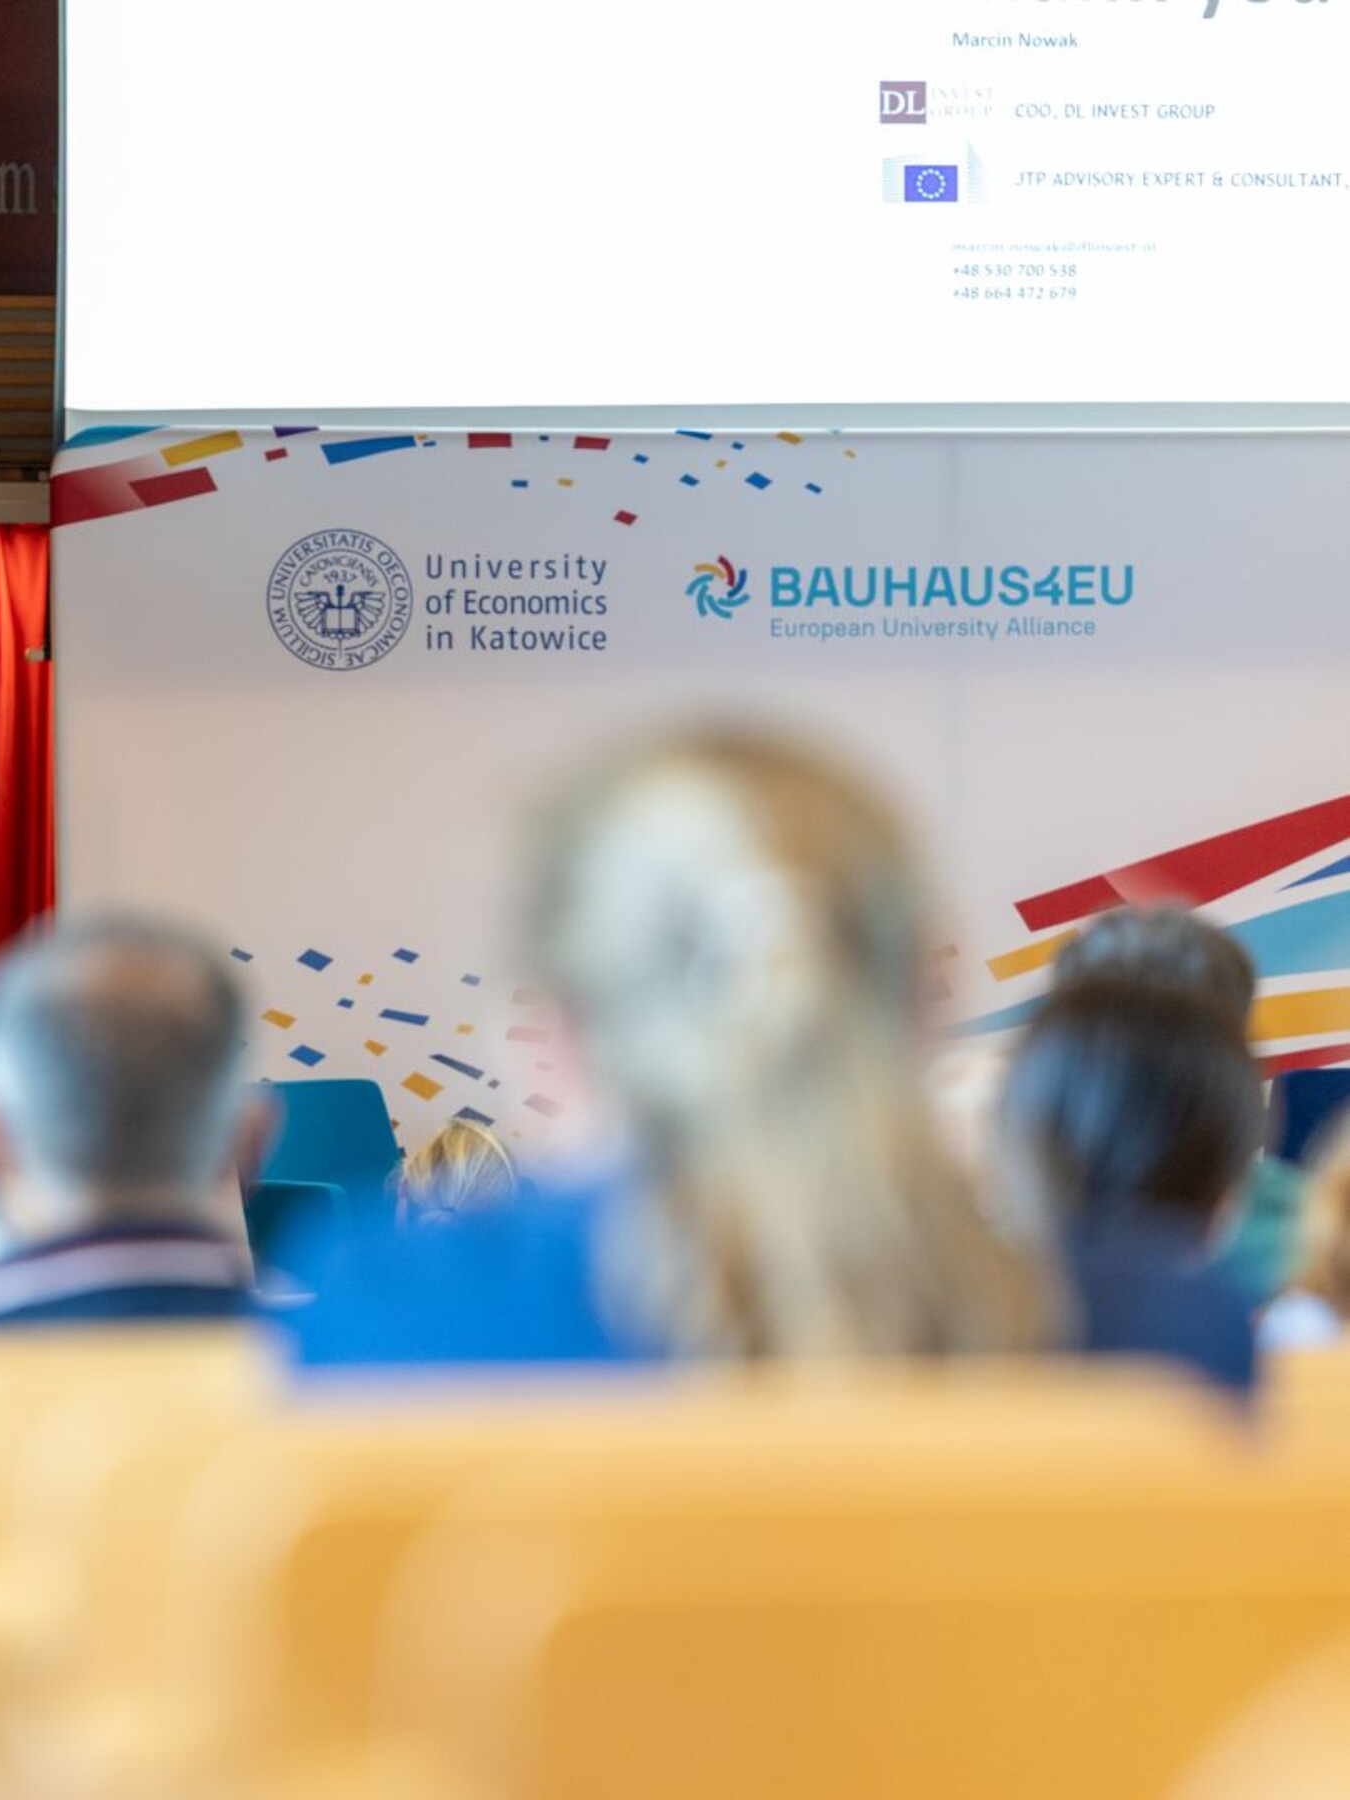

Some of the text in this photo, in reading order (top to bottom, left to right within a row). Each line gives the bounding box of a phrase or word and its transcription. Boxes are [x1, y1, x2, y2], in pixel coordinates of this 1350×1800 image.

[952, 31, 1079, 48] Marcin Nowak
[881, 89, 927, 116] DL
[1014, 104, 1216, 121] COO, DL INVEST GROUP
[1014, 171, 1047, 187] JTP
[1052, 171, 1136, 187] ADVISORY
[1142, 171, 1205, 187] EXPERT
[1212, 171, 1224, 188] &
[953, 264, 1077, 277] +48 530 700 538
[953, 287, 1077, 300] +48 664 472 679
[426, 553, 607, 586] University
[770, 565, 1134, 608] BAUHAUS4EU
[271, 532, 410, 667] SIGILLUM UNIVERSITATIS OECONOMICAE
[425, 589, 607, 615] of Economics
[426, 625, 607, 650] in Katowice
[770, 616, 1096, 642] European University Alliance
